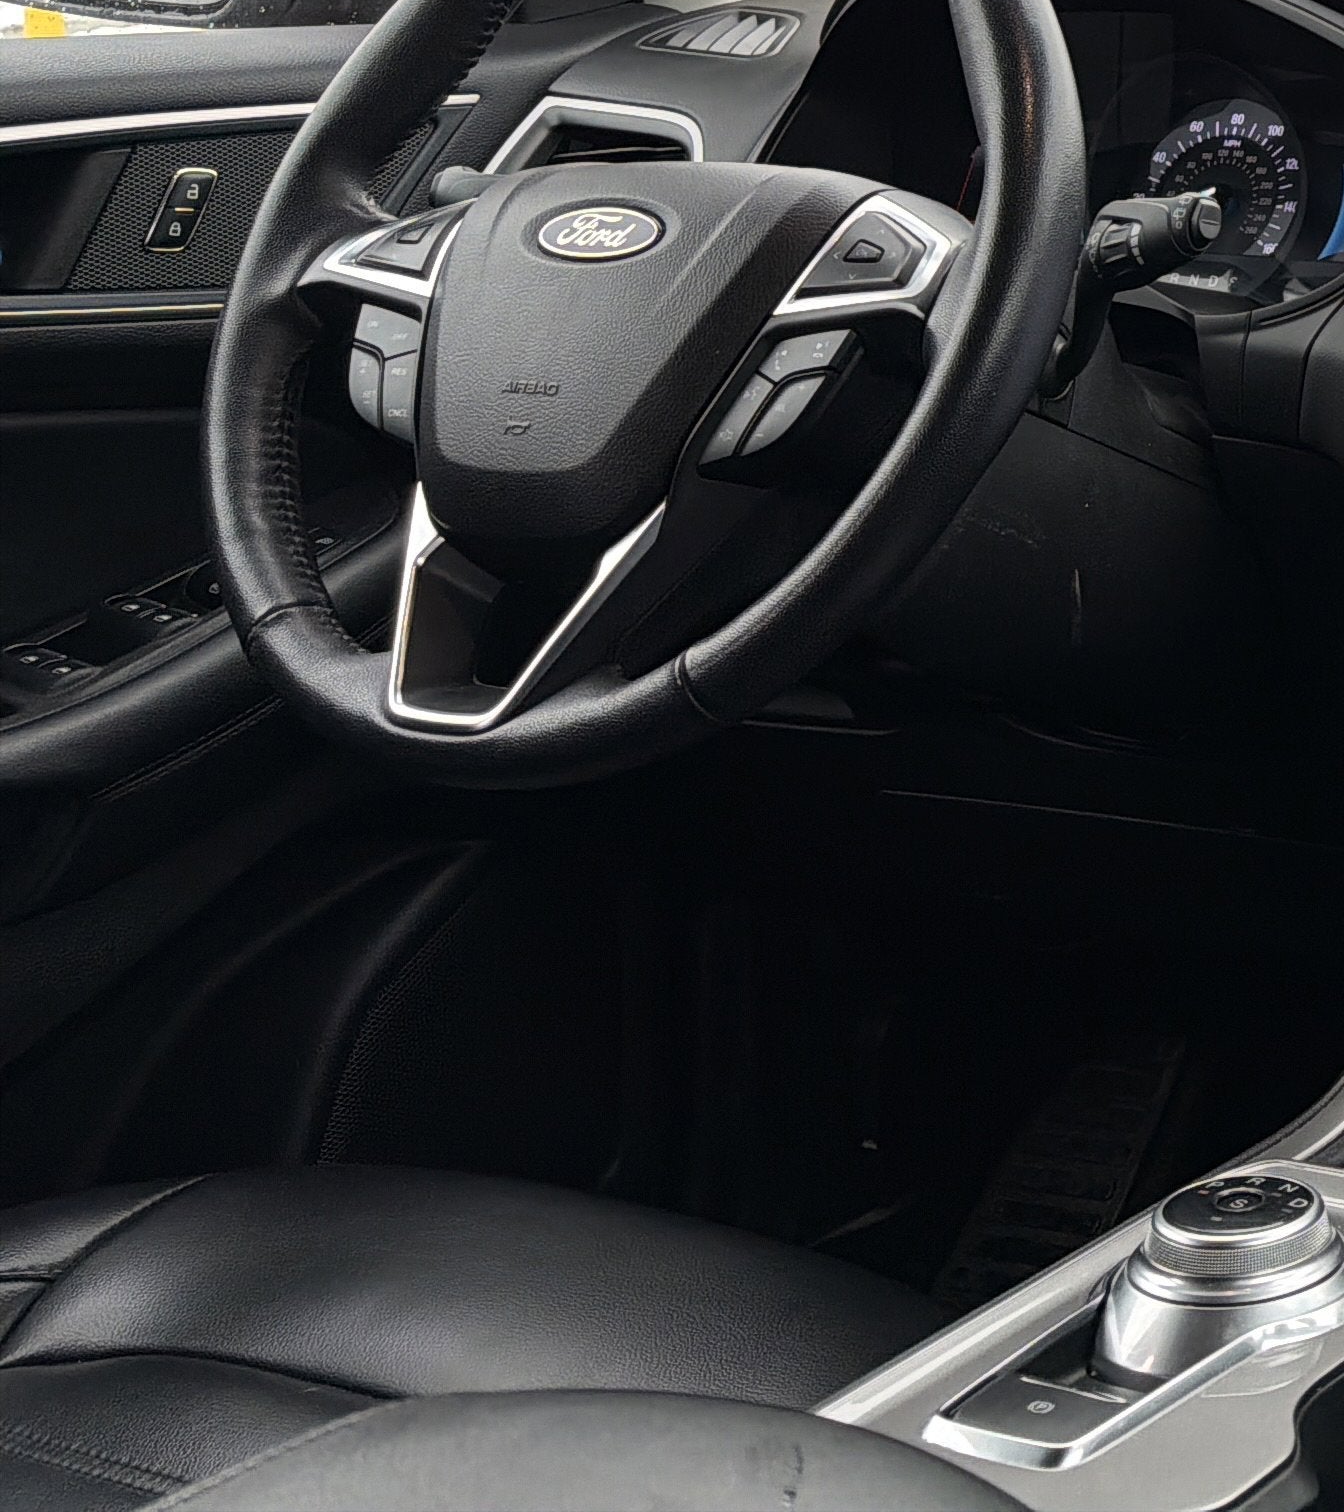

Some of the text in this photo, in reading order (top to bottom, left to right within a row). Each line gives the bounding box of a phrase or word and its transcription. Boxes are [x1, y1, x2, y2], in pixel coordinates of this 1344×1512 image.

[1231, 113, 1245, 125] 80
[1189, 121, 1204, 133] 60
[1267, 125, 1284, 137] 100
[1152, 152, 1166, 164] 40
[556, 212, 636, 248] Ford
[1189, 274, 1200, 286] N
[1208, 275, 1218, 287] D
[502, 379, 560, 396] AIRBAG
[1278, 1184, 1300, 1193] N
[1229, 1198, 1249, 1209] S
[1288, 1197, 1308, 1208] D
